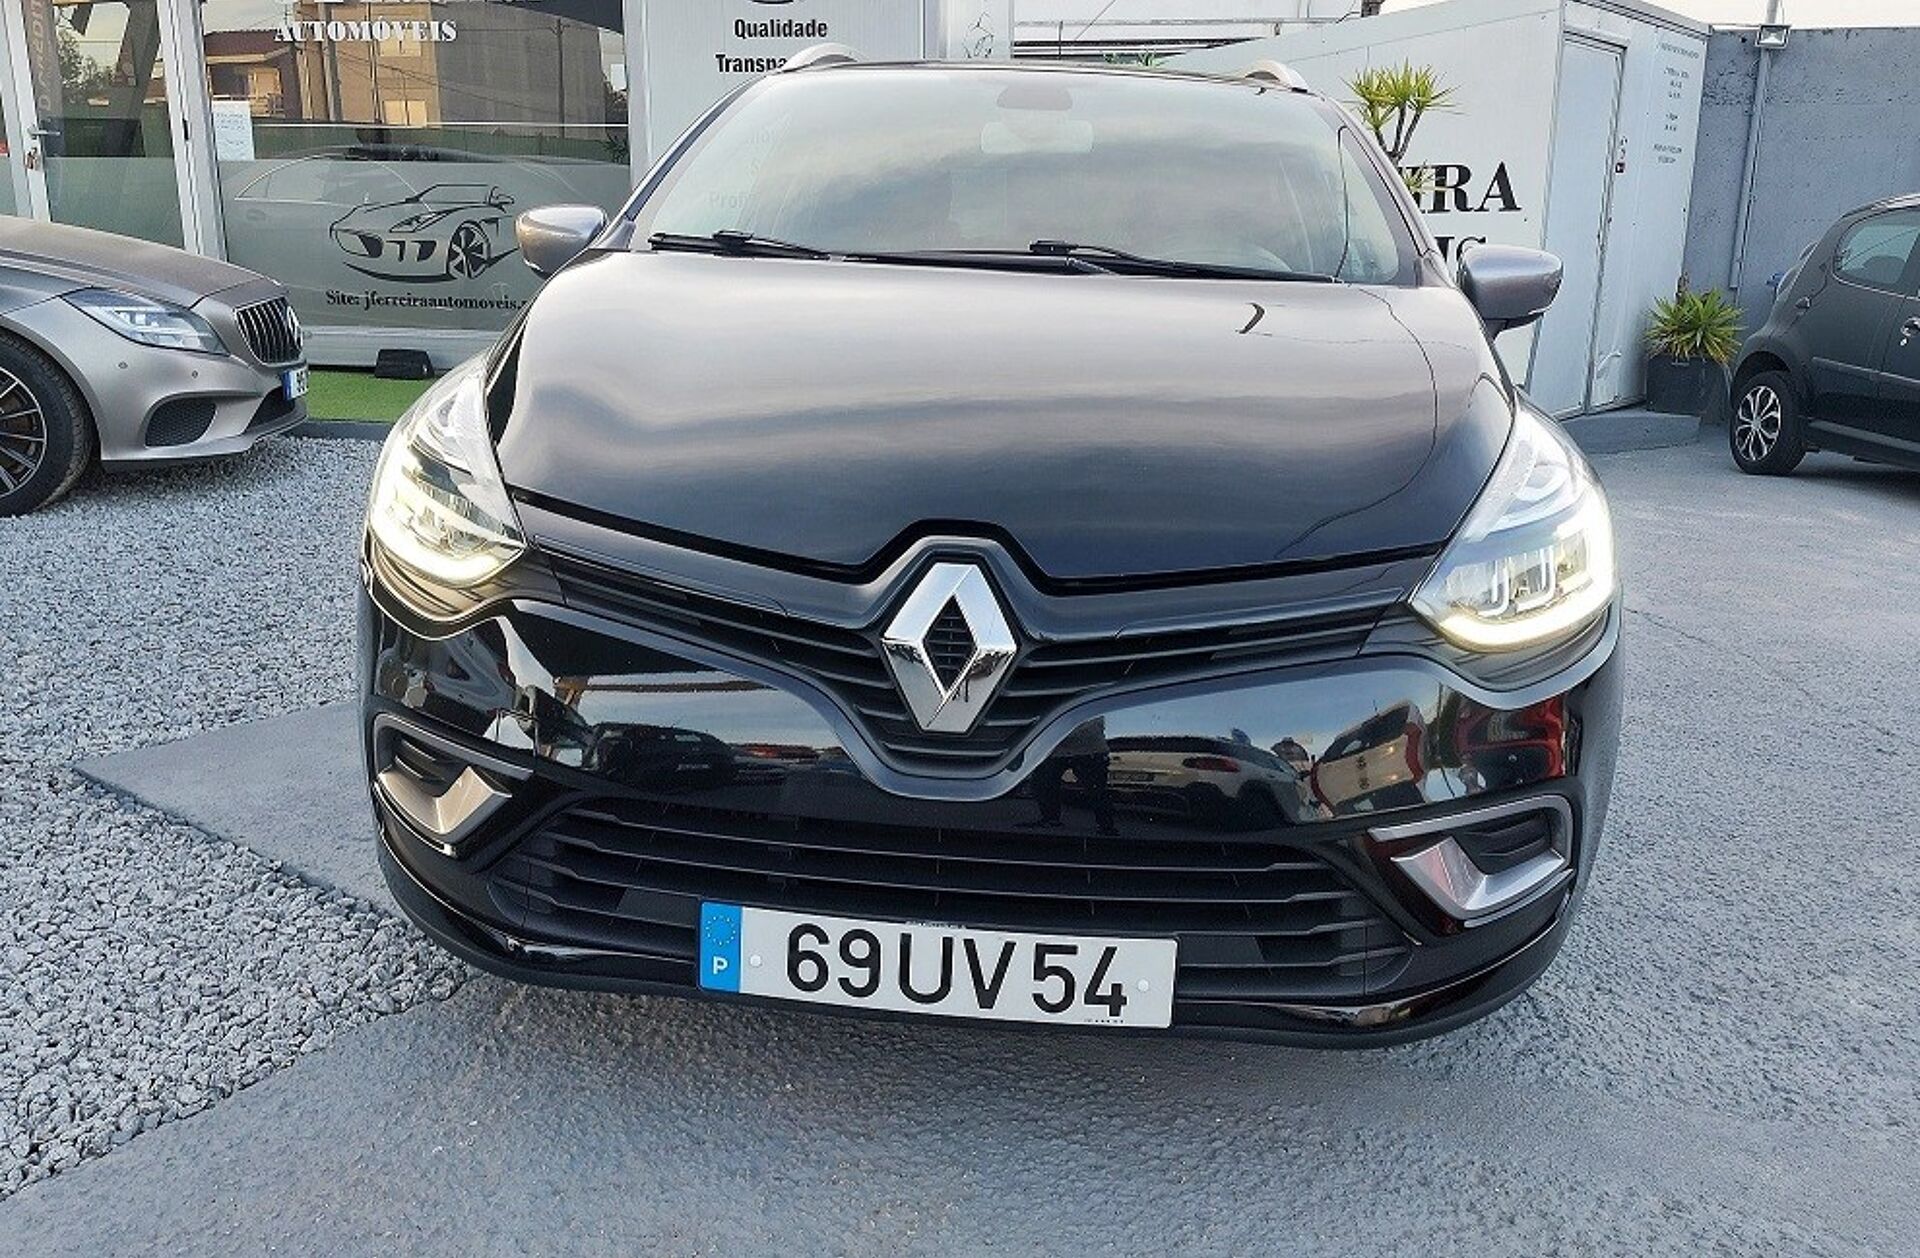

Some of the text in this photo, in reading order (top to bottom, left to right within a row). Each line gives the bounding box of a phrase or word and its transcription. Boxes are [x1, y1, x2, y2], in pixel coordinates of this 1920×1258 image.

[273, 16, 457, 42] AUTOMÓVEIS
[735, 19, 828, 39] Qualidade
[325, 289, 361, 306] Site:
[712, 956, 728, 975] P
